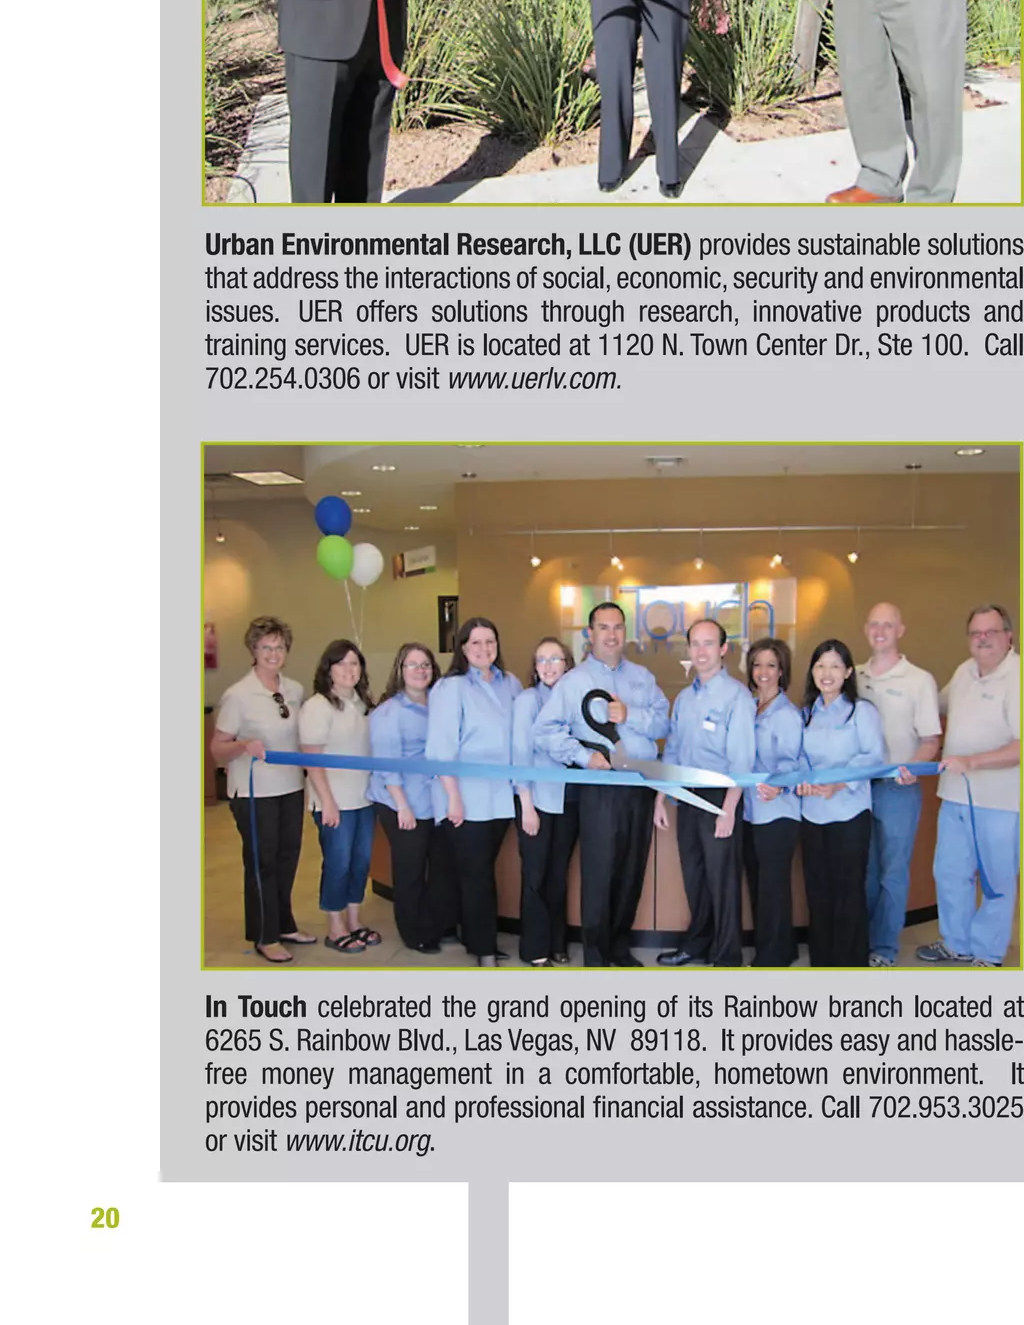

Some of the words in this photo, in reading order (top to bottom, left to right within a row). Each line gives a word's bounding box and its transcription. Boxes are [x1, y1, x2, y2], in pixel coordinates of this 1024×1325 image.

[205, 232, 275, 256] Urban
[281, 232, 450, 256] Environmental
[457, 232, 572, 261] Research,
[578, 232, 622, 256] LLC
[628, 232, 692, 261] (UER)
[699, 232, 791, 261] provides
[797, 232, 921, 256] sustainable
[927, 232, 1024, 256] solutions
[204, 332, 287, 362] training
[294, 332, 390, 357] services.
[405, 332, 450, 357] UER
[457, 332, 475, 357] is
[483, 332, 561, 357] located
[569, 333, 591, 357] at
[598, 332, 654, 357] 1120
[662, 332, 684, 357] N.
[689, 332, 748, 357] Town
[756, 332, 828, 357] Center
[835, 332, 870, 360] Dr.,
[877, 332, 913, 357] Ste
[921, 333, 969, 357] 100.
[984, 332, 1024, 357] Call
[205, 994, 227, 1018] In
[237, 994, 307, 1019] Touch
[317, 994, 432, 1019] celebrated
[441, 994, 477, 1018] the
[487, 994, 549, 1024] grand
[560, 994, 646, 1024] opening
[657, 994, 679, 1019] of
[688, 994, 714, 1018] its
[724, 994, 819, 1019] Rainbow
[828, 994, 903, 1019] branch
[914, 994, 992, 1019] located
[1003, 995, 1024, 1019] at
[205, 1133, 228, 1152] or
[233, 1128, 278, 1152] visit
[286, 1128, 435, 1158] www.itcu.org.
[90, 1206, 121, 1230] 20
